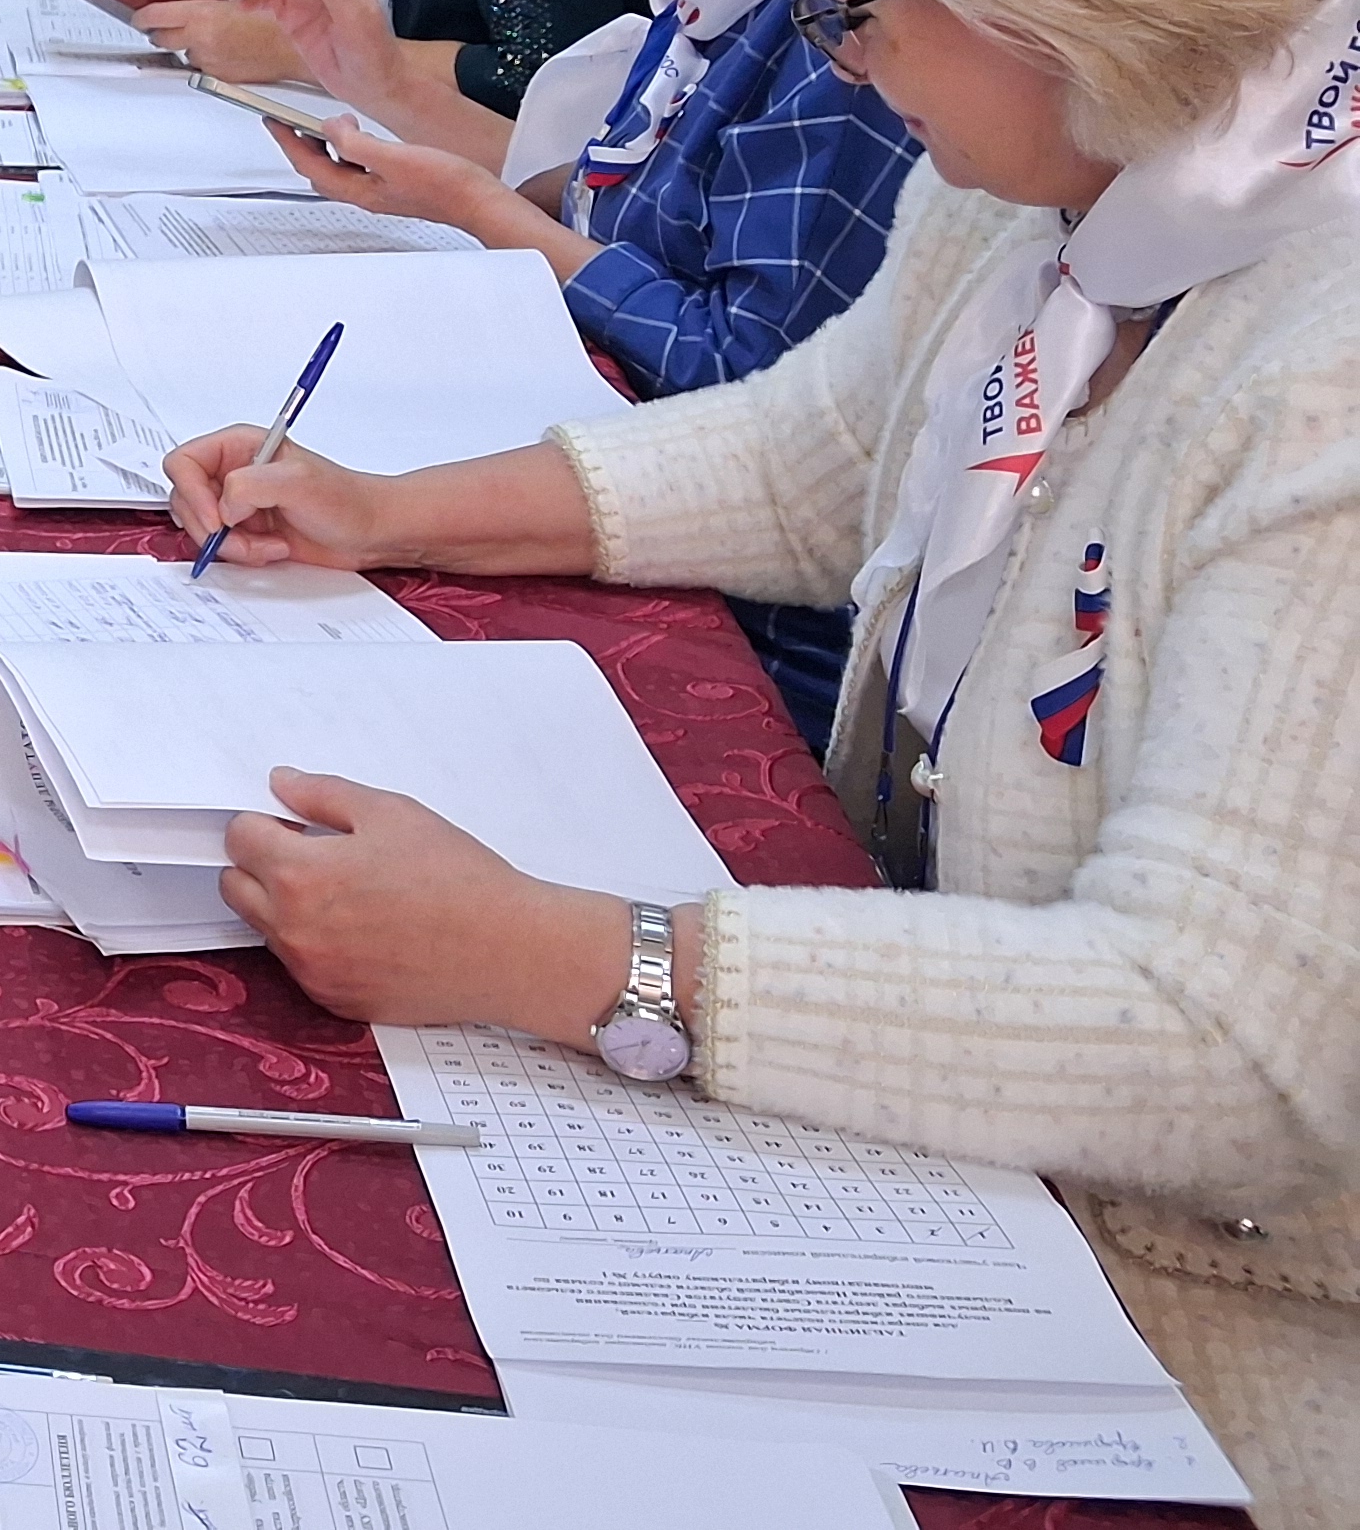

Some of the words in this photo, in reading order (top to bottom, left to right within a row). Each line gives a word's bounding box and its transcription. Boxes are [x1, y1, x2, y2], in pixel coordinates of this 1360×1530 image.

[1306, 61, 1360, 150] ТВОЙ
[735, 1323, 796, 1332] ФОРМА
[802, 1326, 905, 1337] ТАБЛИЧНАЯ
[175, 1436, 212, 1467] 62
